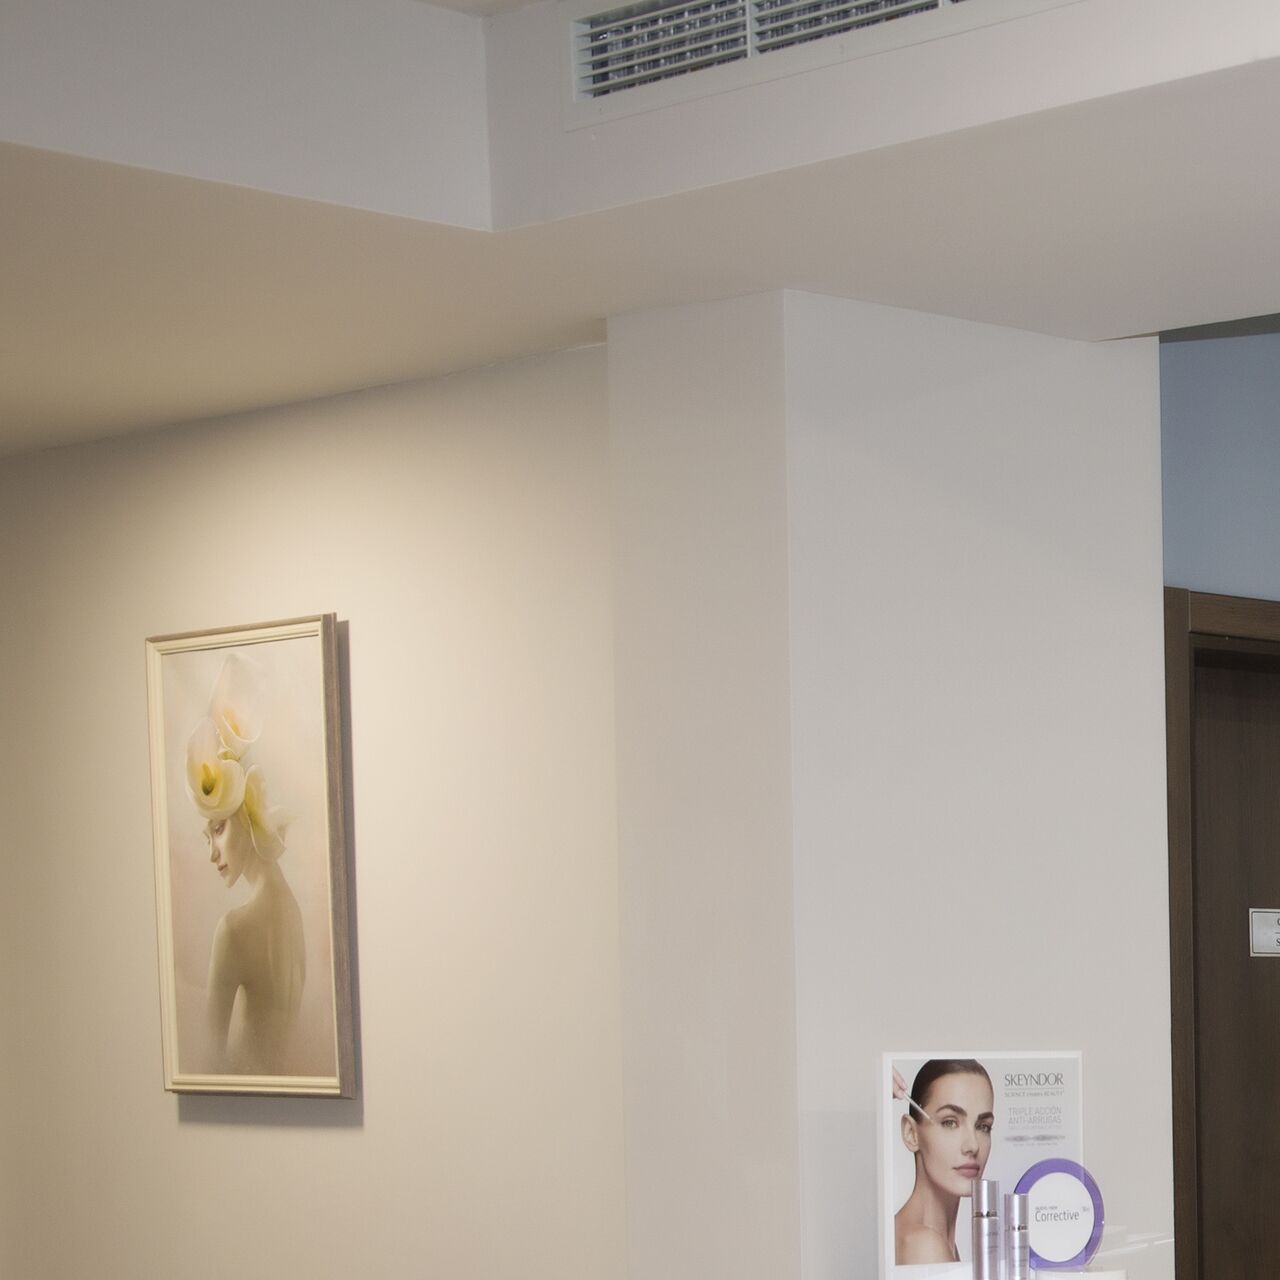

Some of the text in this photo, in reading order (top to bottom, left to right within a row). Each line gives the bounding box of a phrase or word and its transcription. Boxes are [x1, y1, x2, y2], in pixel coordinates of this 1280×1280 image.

[1004, 1072, 1064, 1087] SKEYNDOR
[1008, 1107, 1033, 1116] TRIPLE
[1035, 1210, 1080, 1222] Corrective
